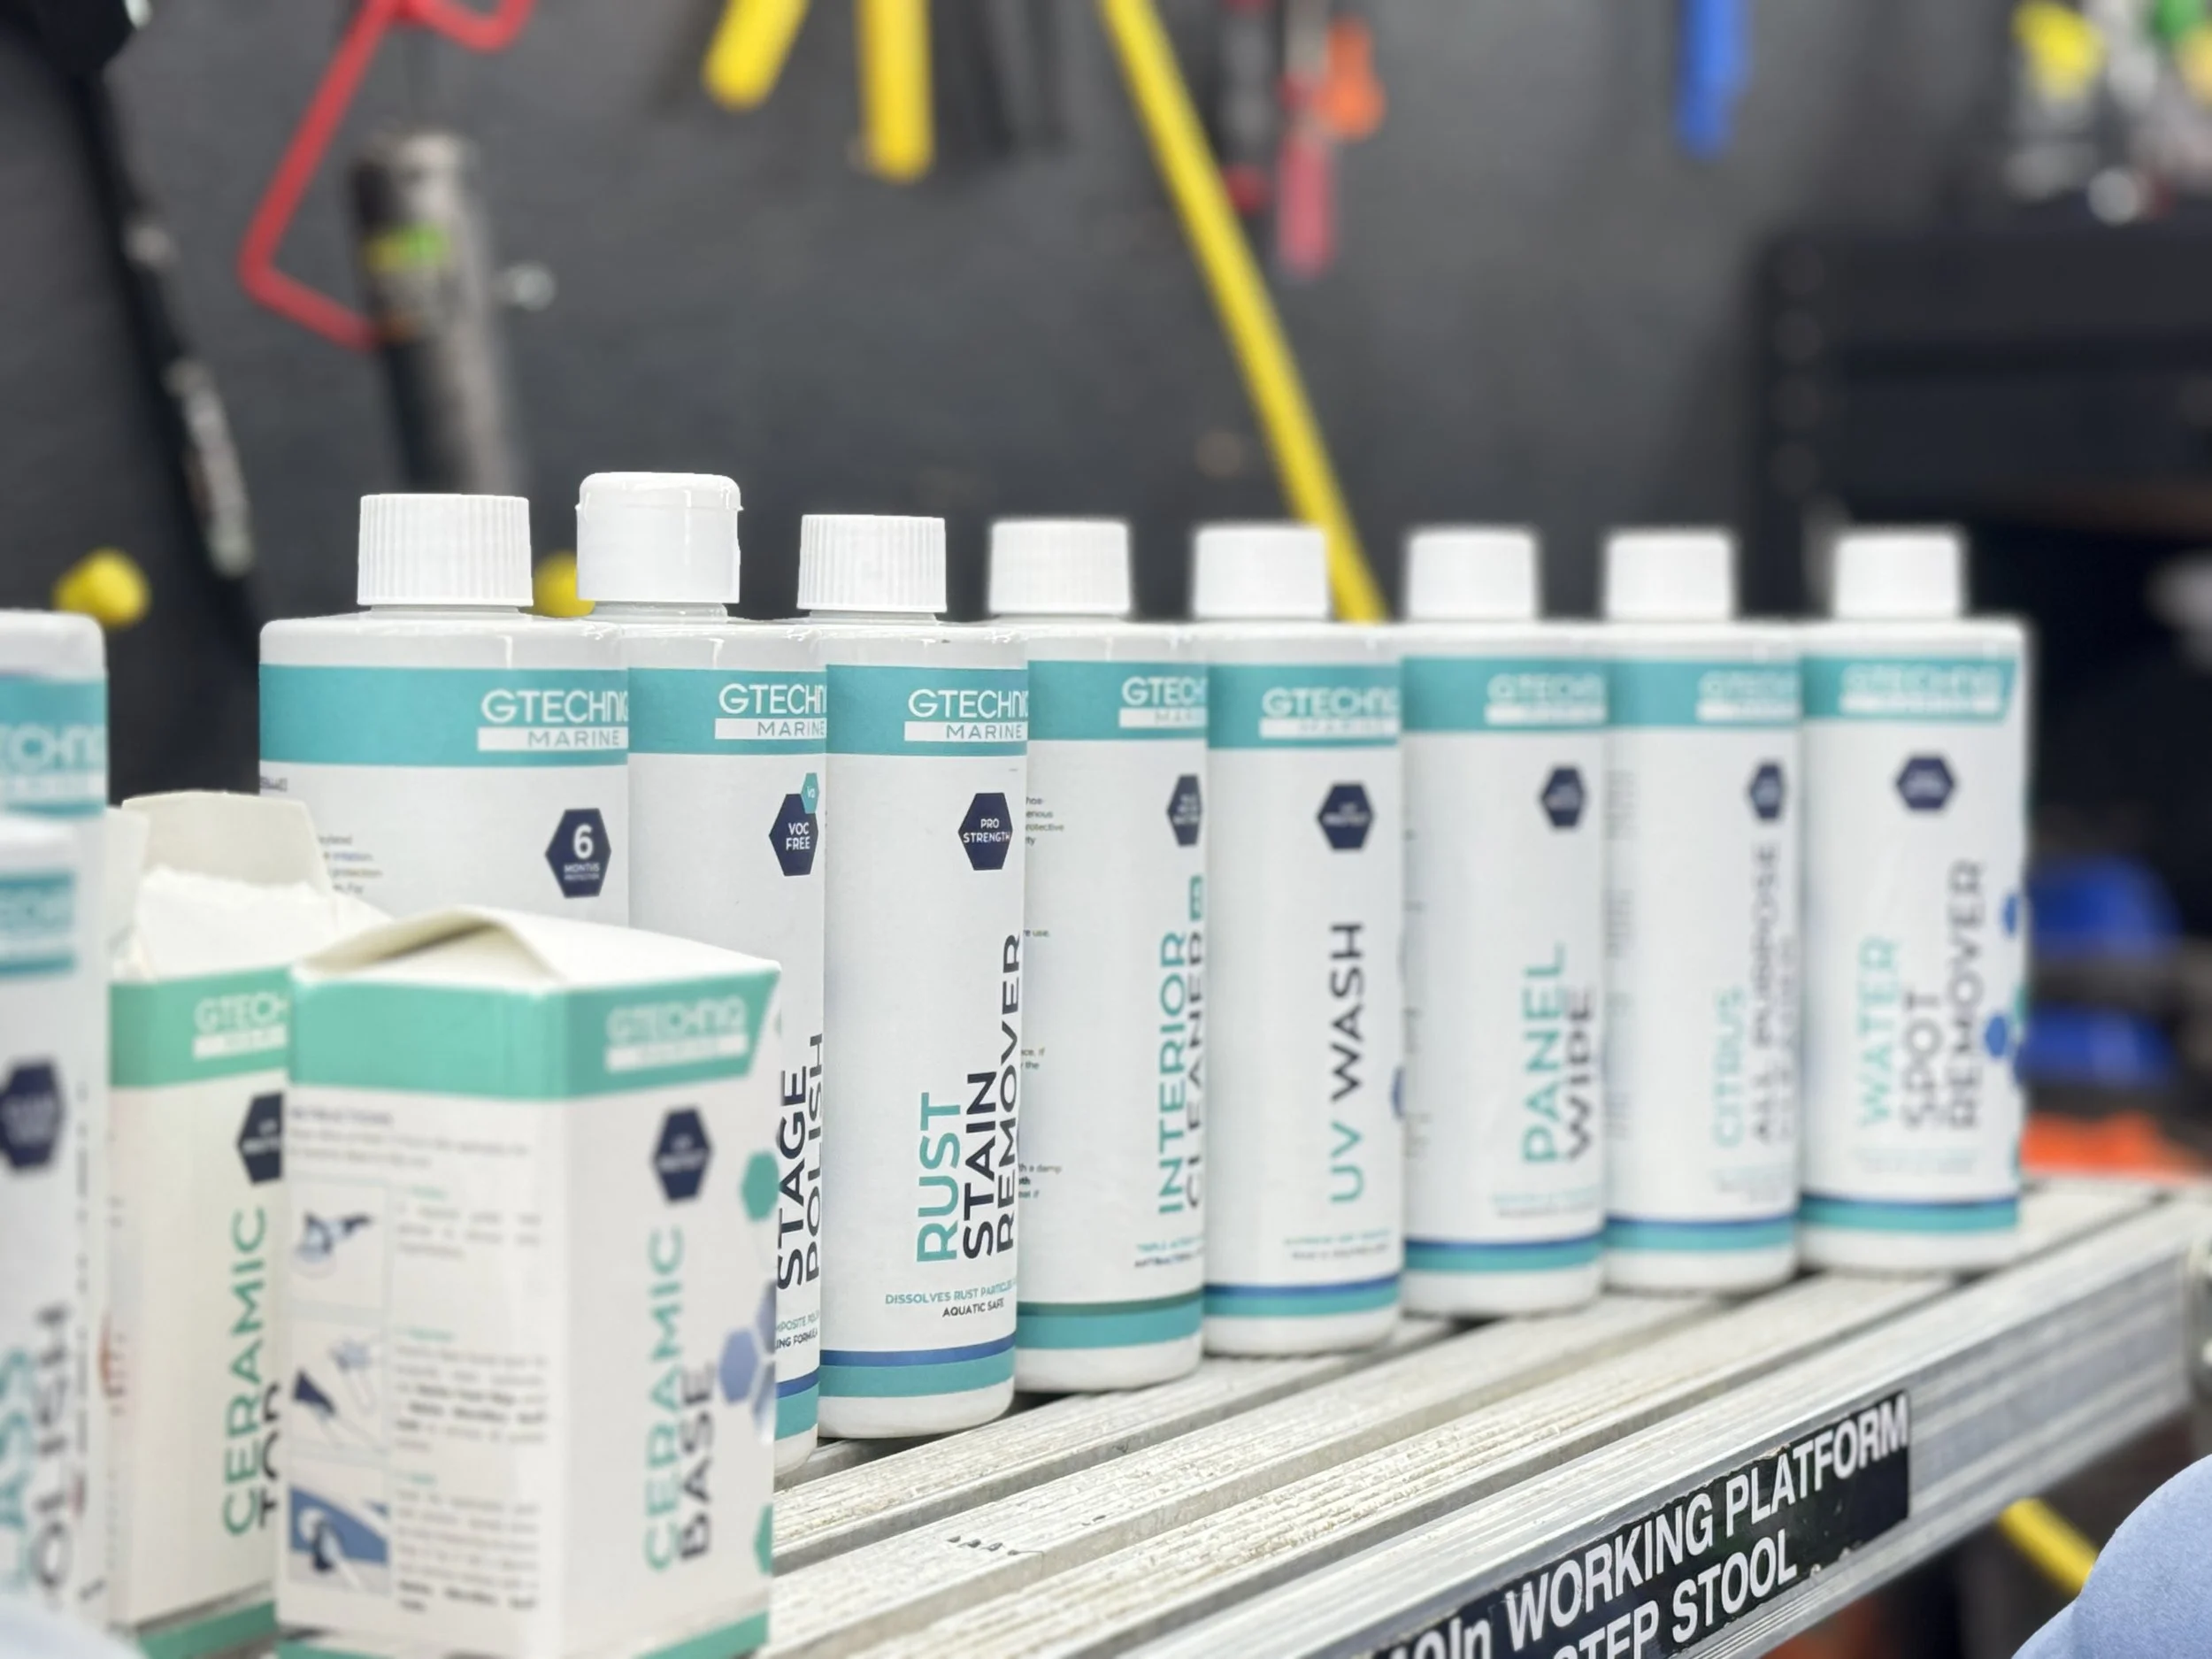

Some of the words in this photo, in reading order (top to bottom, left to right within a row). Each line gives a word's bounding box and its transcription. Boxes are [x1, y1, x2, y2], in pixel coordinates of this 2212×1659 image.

[527, 730, 620, 748] MARINE
[757, 721, 826, 737] MARINE
[947, 725, 1022, 740] MARINE
[572, 823, 594, 860] 6
[786, 836, 810, 851] FREE
[788, 823, 810, 835] VOC
[963, 832, 1011, 843] STRENGTH
[980, 818, 999, 829] PRO
[1158, 932, 1187, 1214] INTERIOR
[1330, 922, 1363, 1102] WASH
[1521, 940, 1565, 1164] PANEL
[1565, 985, 1593, 1163] WIPE
[1857, 936, 1898, 1127] WATER
[1904, 990, 1944, 1130] SPOT
[1947, 857, 1985, 1130] REMOVER
[777, 1065, 806, 1291] STAGE
[806, 1033, 822, 1283] POLISH
[917, 1092, 961, 1262] RUST
[963, 1071, 997, 1260] STAIN
[996, 933, 1020, 1254] REMOVER
[1330, 1119, 1363, 1204] UV
[221, 1205, 267, 1537] CERAMIC
[885, 1291, 951, 1304] DISSOLVES
[954, 1288, 978, 1301] RUST
[942, 1302, 986, 1317] AQUATIC
[987, 1298, 1004, 1311] SAFE
[642, 1225, 684, 1573] CERAMIC
[680, 1361, 715, 1561] BASE
[1506, 1493, 1713, 1653] WORKING
[1725, 1393, 1909, 1532] PLATFORM
[1552, 1601, 1659, 1659] TEP
[1671, 1527, 1797, 1645] STOOL
